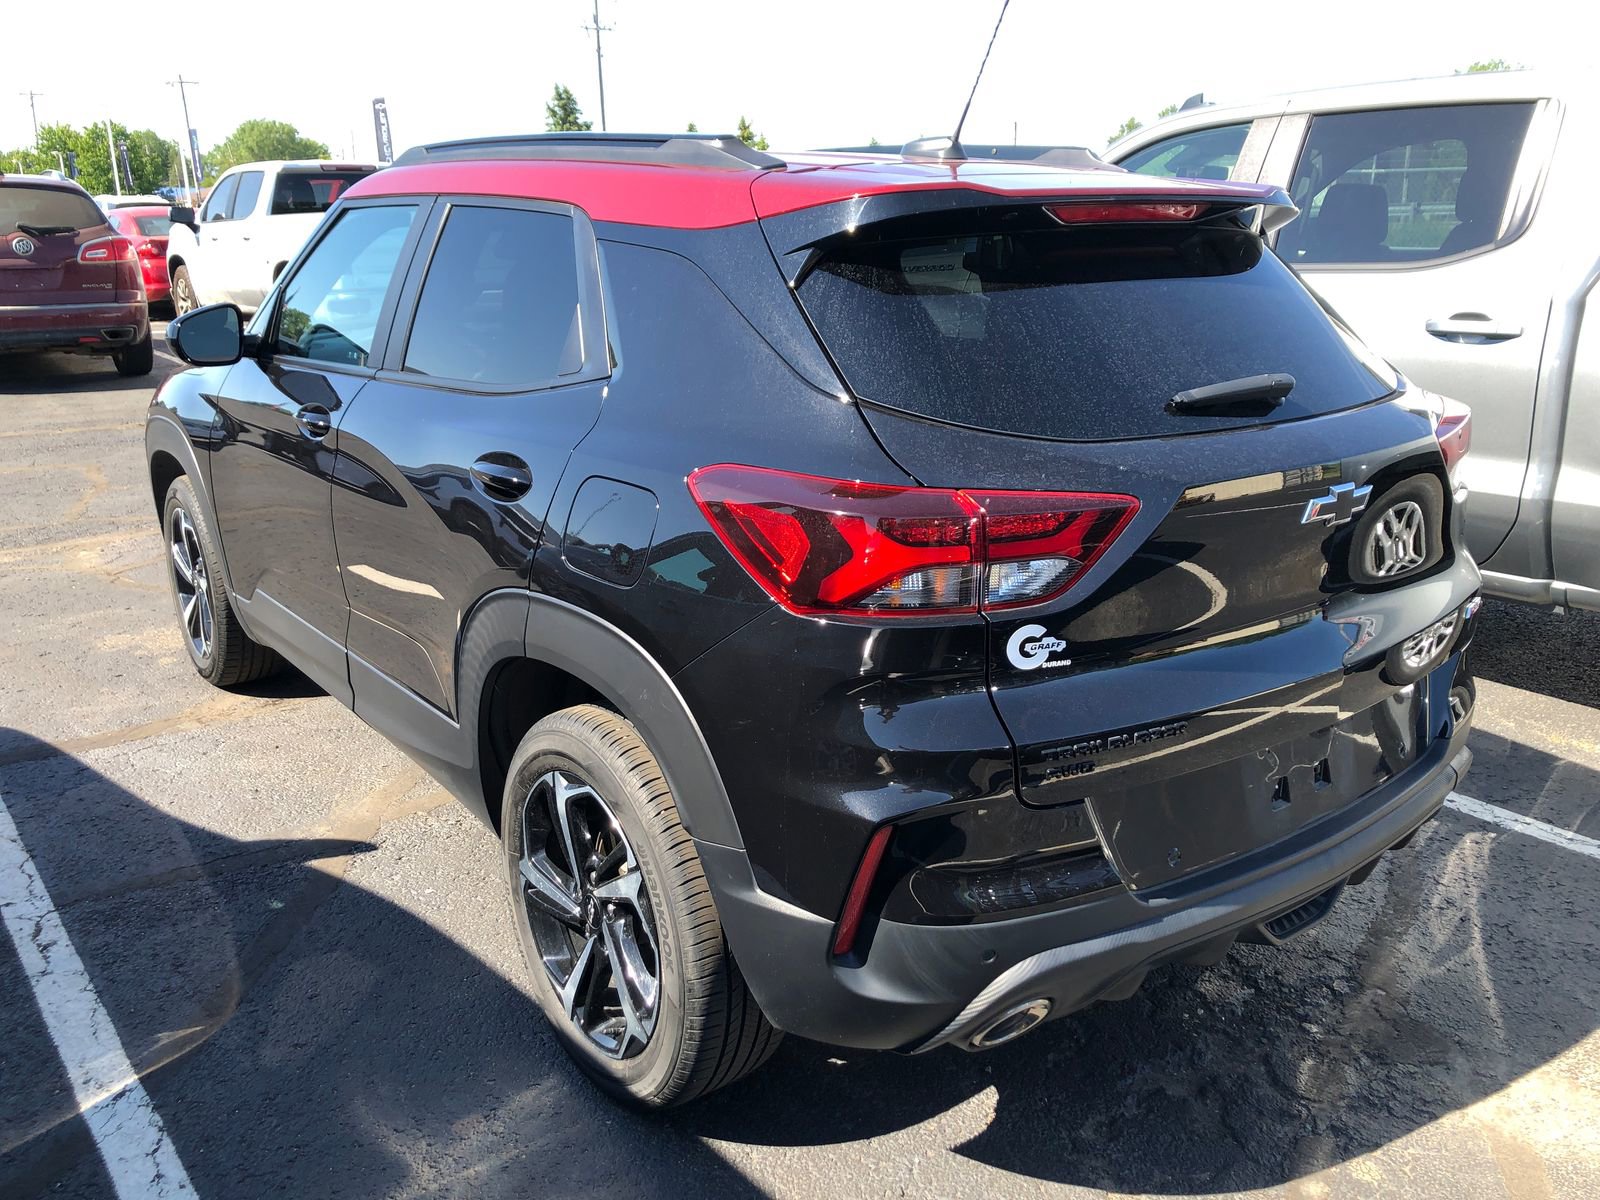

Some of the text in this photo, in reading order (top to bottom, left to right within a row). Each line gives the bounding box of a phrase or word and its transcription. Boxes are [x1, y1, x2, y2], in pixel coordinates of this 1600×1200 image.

[1030, 642, 1062, 651] GRAFF
[1042, 659, 1072, 668] DURAND
[1041, 721, 1189, 760] TRAILBLAZER
